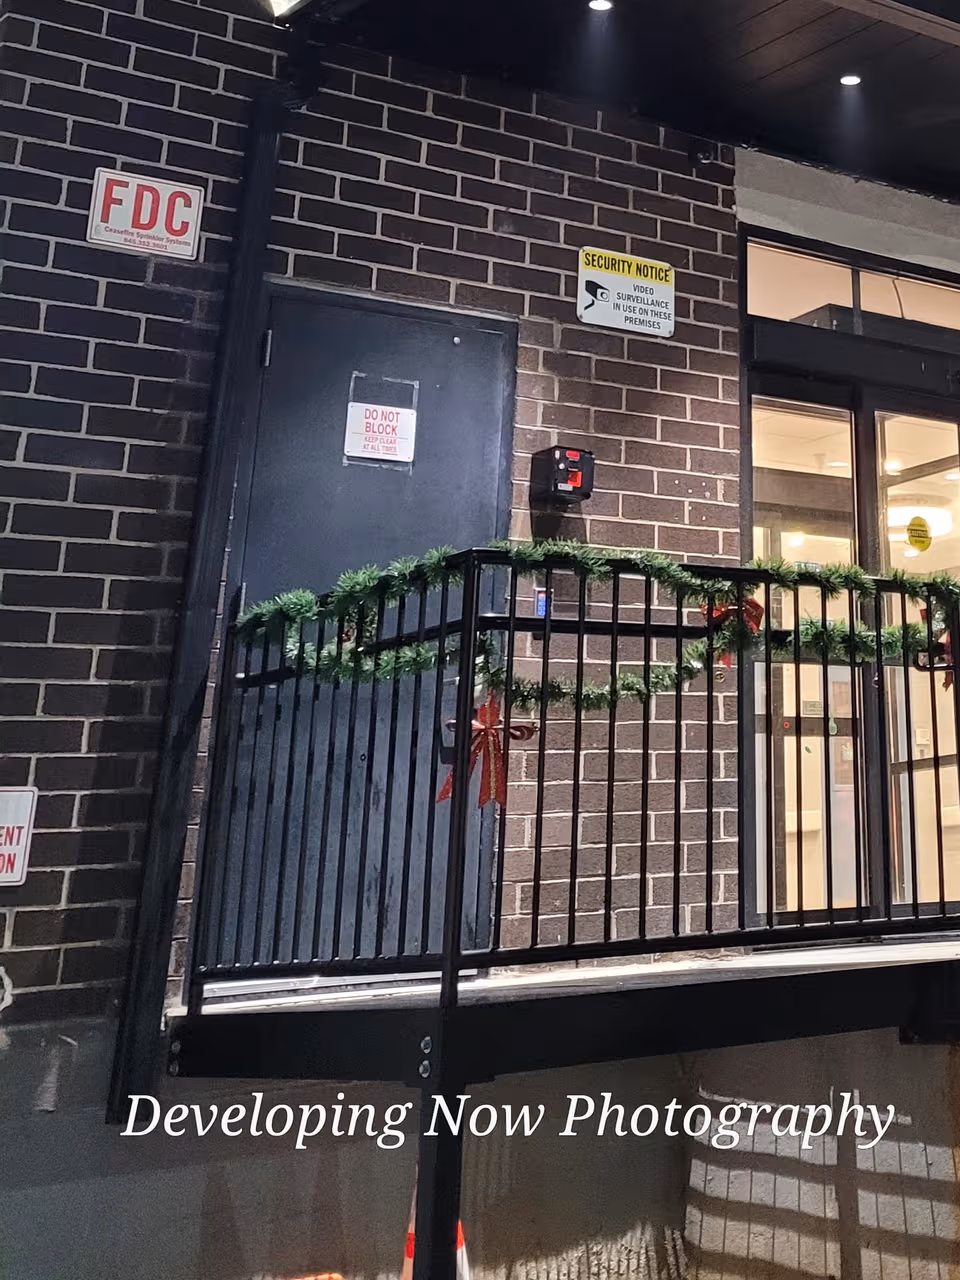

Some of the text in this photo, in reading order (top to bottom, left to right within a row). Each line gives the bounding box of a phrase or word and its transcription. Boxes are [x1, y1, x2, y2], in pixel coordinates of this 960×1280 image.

[100, 178, 192, 237] FDC
[584, 252, 670, 282] SECURITY NOTICE
[633, 284, 654, 296] VIDEO
[616, 292, 670, 310] SURVEILLANCE
[613, 303, 672, 321] IN USE ON THESE
[624, 316, 661, 329] PREMISES
[365, 408, 400, 423] DO NOT
[365, 422, 398, 436] BLOCK
